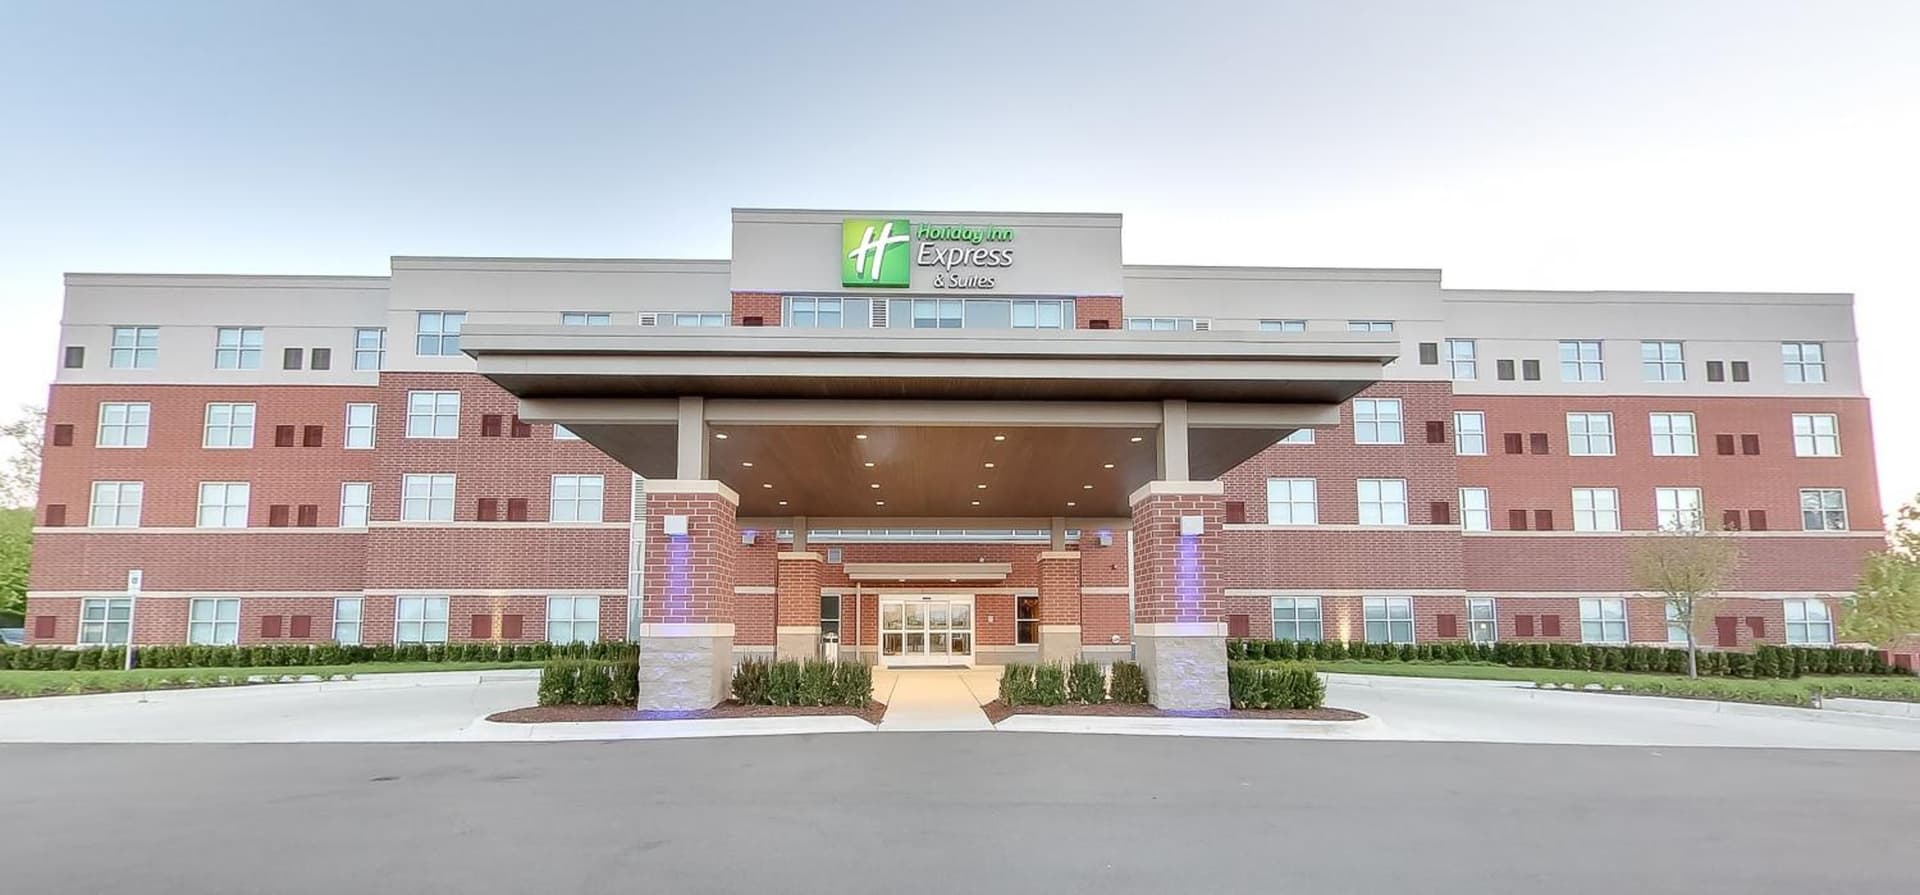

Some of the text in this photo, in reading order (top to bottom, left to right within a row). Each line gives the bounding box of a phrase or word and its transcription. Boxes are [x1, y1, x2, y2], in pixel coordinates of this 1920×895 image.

[917, 224, 1014, 245] Holiday Inn
[849, 223, 909, 280] H
[917, 242, 1014, 271] Express
[934, 272, 996, 289] & Suites
